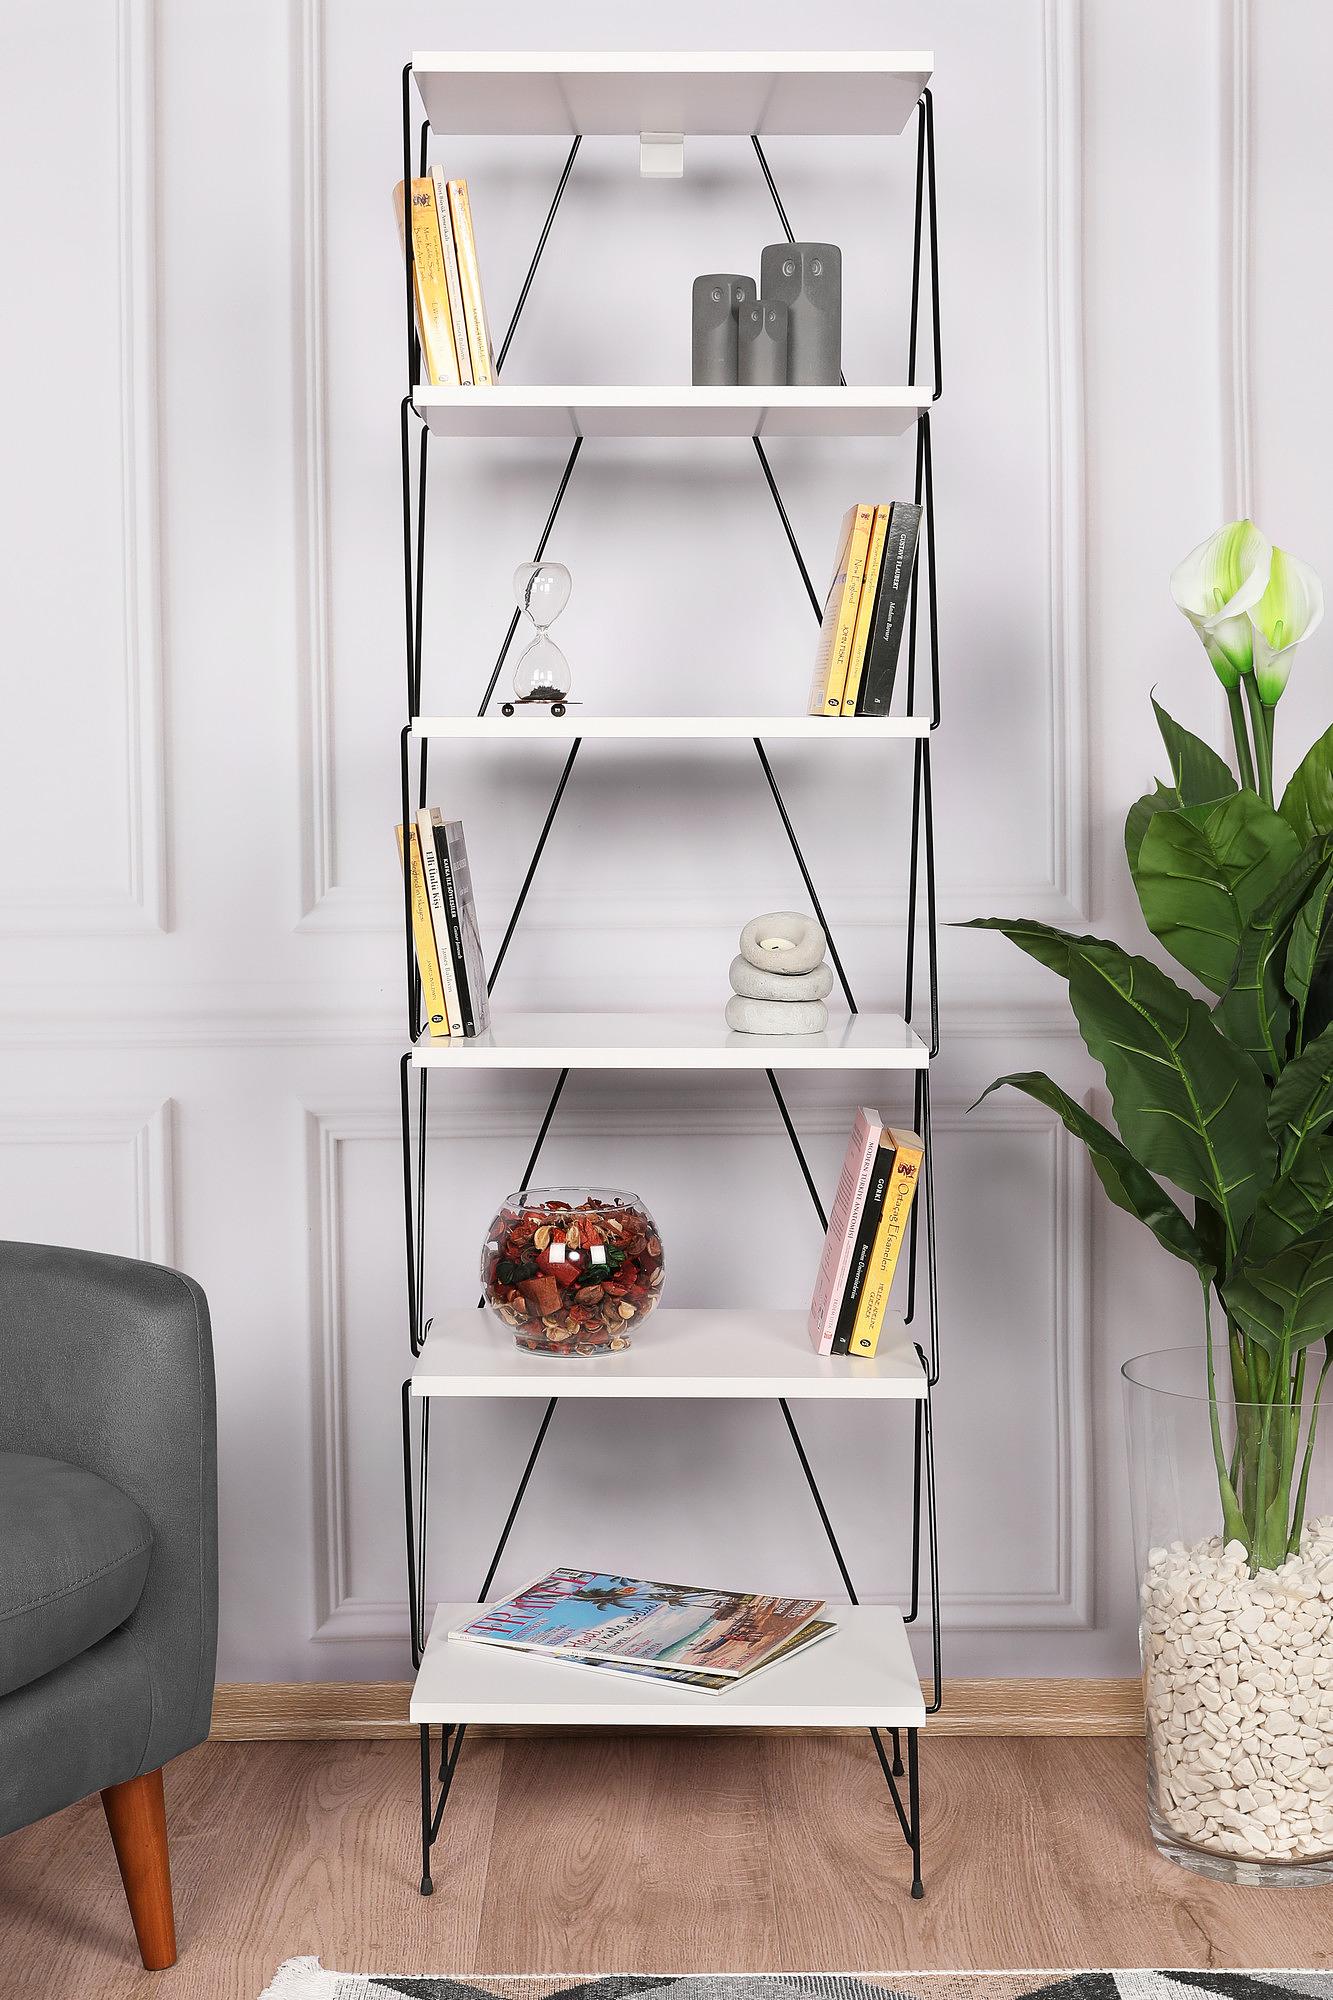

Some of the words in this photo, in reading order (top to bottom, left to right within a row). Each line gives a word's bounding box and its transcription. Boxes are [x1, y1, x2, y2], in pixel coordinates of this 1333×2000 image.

[897, 534, 906, 560] GUSTAVE
[854, 559, 862, 574] New
[892, 560, 902, 590] FLAUBERT
[849, 576, 860, 606] England
[883, 622, 892, 642] Bovary
[426, 851, 434, 866] Elli
[429, 868, 438, 890] Ünlü
[432, 892, 442, 909] Kişi
[864, 1141, 874, 1172] MODERN
[860, 1244, 868, 1261] Benim
[880, 1224, 900, 1272] Efsaneleri
[464, 1571, 598, 1637] TRAVEL
